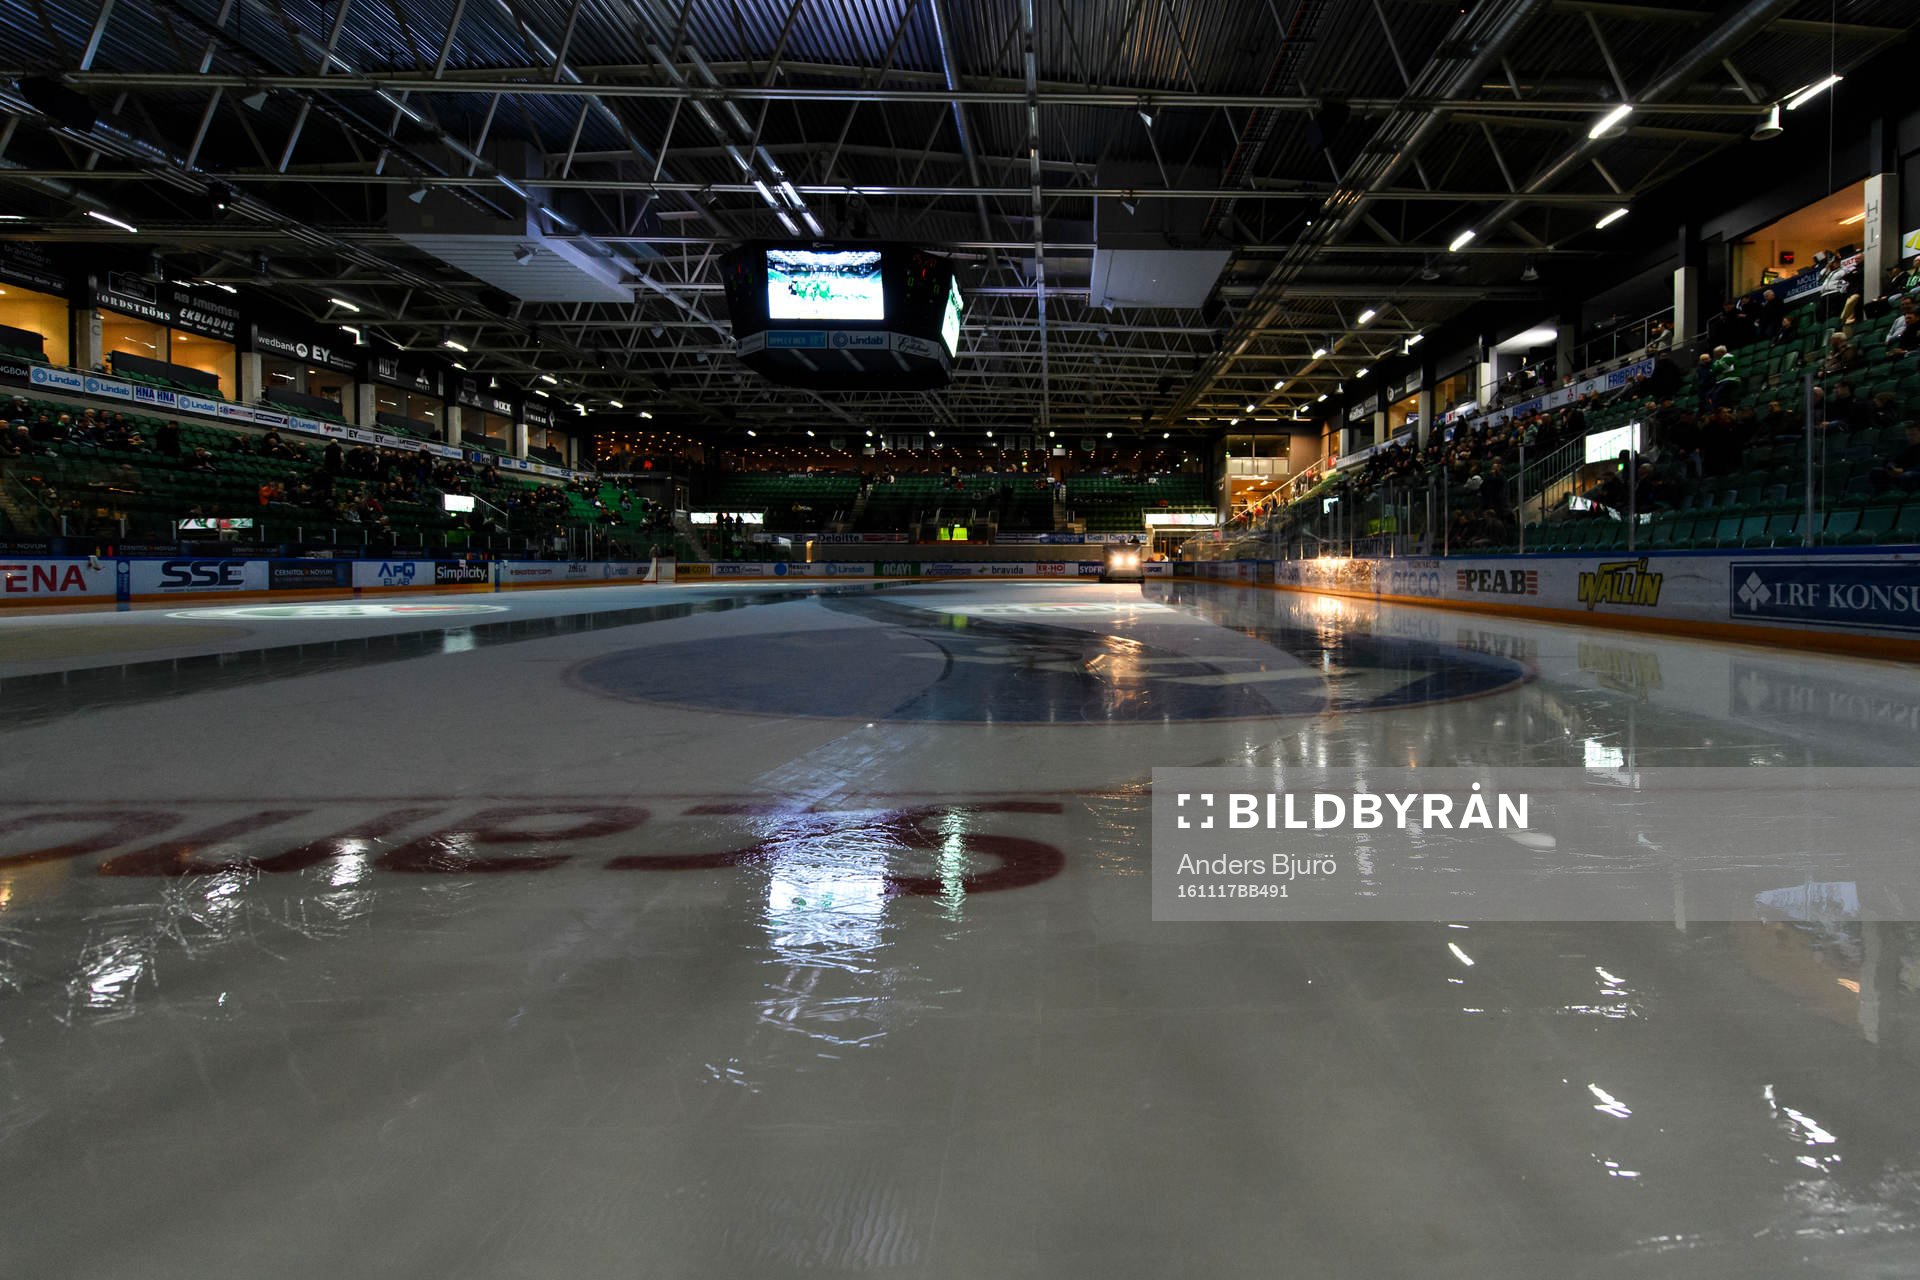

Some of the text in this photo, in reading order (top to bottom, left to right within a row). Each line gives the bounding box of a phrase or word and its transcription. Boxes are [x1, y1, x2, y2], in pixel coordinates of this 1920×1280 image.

[258, 335, 296, 353] wedbank
[849, 334, 883, 345] Lindab
[312, 345, 331, 363] EY
[48, 373, 81, 387] Lindab
[100, 383, 130, 396] Lindab
[191, 400, 216, 412] Lindab
[0, 564, 88, 593] ENA
[157, 560, 247, 588] SSE
[991, 565, 1024, 575] bravida
[1465, 569, 1527, 595] PEAB
[1578, 557, 1663, 611] WALLIN
[1775, 582, 1820, 607] LRF
